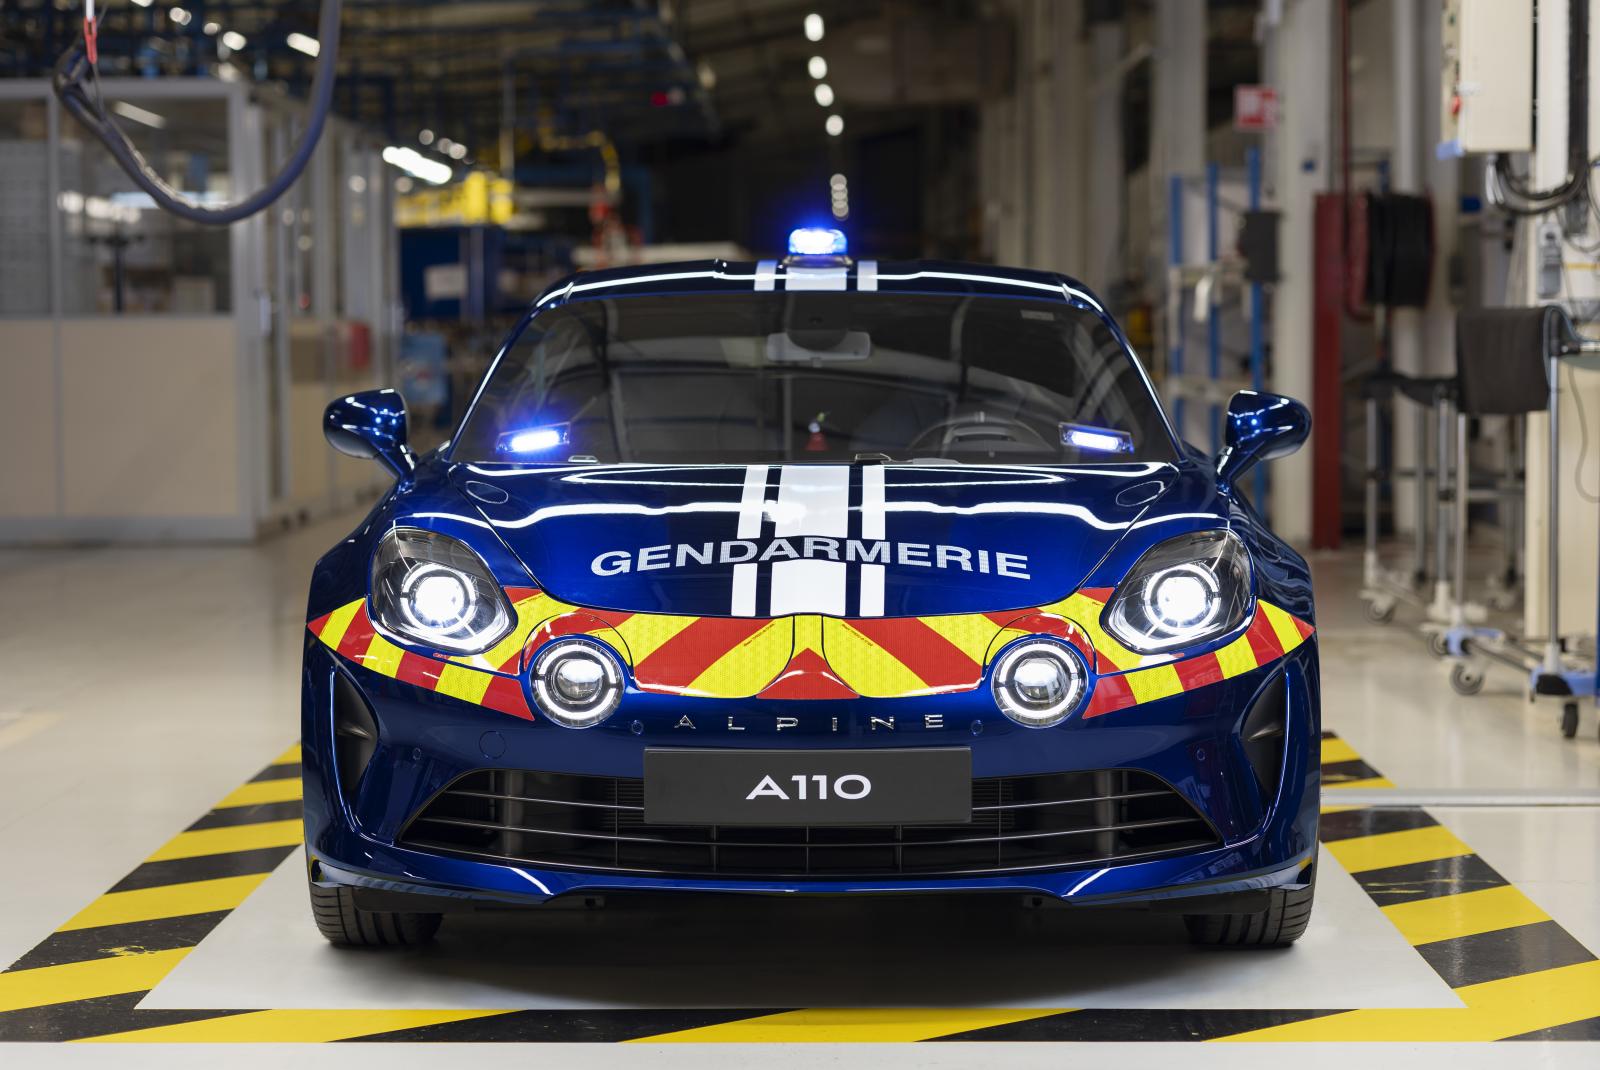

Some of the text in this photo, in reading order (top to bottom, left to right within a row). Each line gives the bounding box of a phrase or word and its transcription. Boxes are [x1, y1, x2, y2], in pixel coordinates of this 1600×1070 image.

[591, 537, 1031, 580] GENDARMERIE
[674, 714, 944, 732] ALPINE
[745, 774, 872, 801] A110
